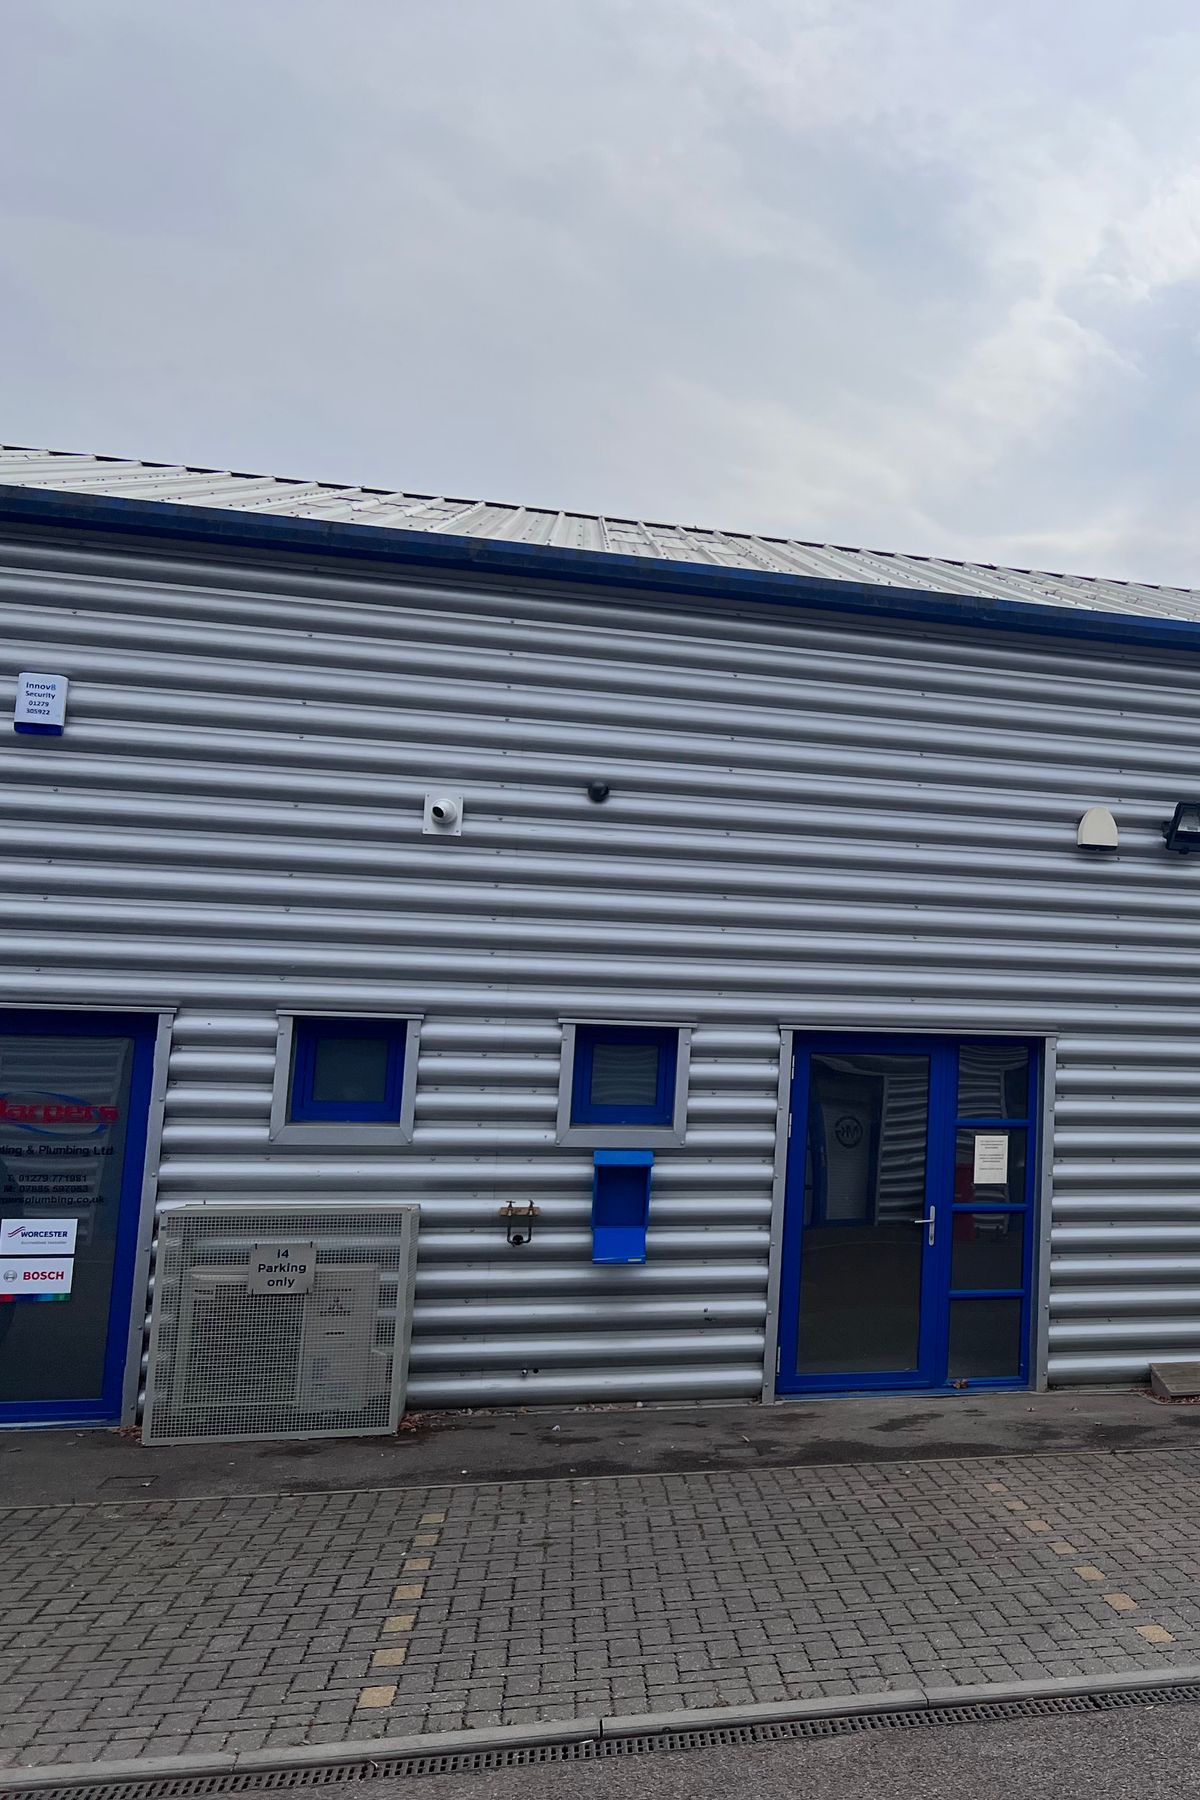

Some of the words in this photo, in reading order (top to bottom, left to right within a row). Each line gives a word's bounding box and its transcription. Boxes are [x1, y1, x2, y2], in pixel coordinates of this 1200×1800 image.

[26, 682, 57, 691] Innov8
[25, 691, 56, 699] Security
[26, 1146, 34, 1155] &
[38, 1145, 90, 1157] Plumbing
[94, 1146, 114, 1156] Ltd
[18, 1174, 48, 1182] 01279
[277, 1249, 289, 1258] 14
[258, 1263, 307, 1274] Parking
[23, 1271, 65, 1281] BOSCH
[267, 1277, 295, 1288] only
